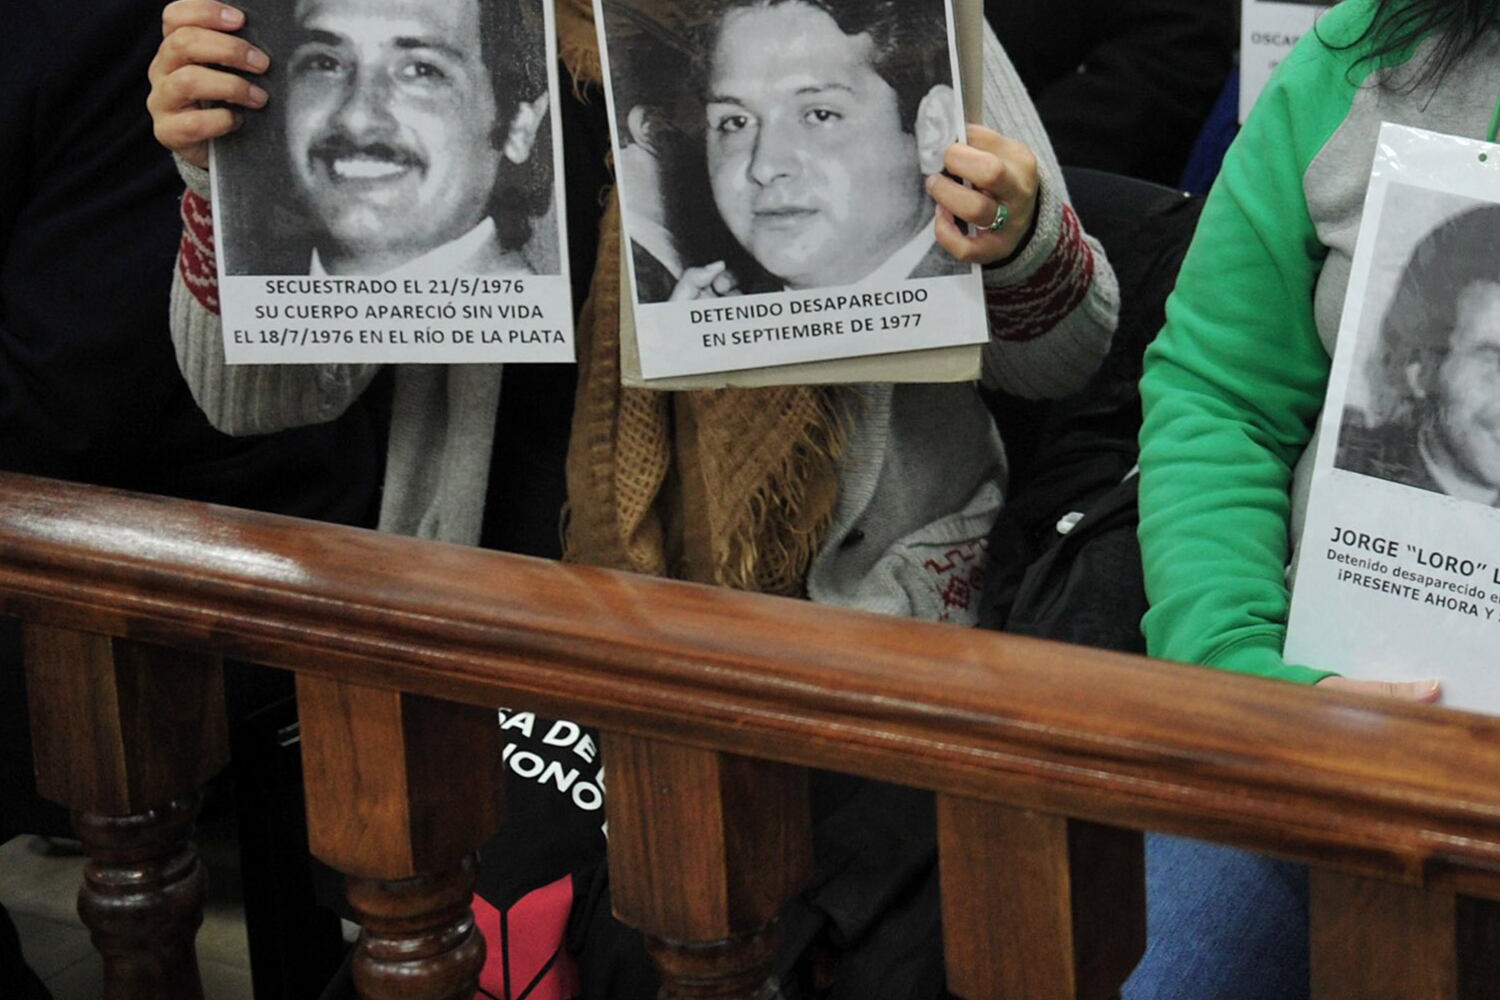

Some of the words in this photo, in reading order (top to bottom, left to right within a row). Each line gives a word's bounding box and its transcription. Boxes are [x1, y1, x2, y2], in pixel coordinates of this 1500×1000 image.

[266, 279, 398, 295] SECUESTRADO
[403, 279, 423, 294] EL
[428, 277, 525, 296] 21/5/1976
[255, 305, 279, 319] SU
[284, 305, 359, 320] CUERPO
[365, 301, 455, 319] APARECIÓ
[462, 304, 492, 319] SIN
[498, 304, 544, 319] VIDA
[690, 303, 783, 324] DETENIDO
[790, 289, 928, 315] DESAPARECIDO
[234, 330, 254, 344] EL
[259, 328, 354, 346] 18/7/1976
[359, 330, 383, 344] EN
[389, 330, 408, 344] EL
[414, 327, 446, 344] RÍO
[452, 330, 474, 344] DE
[481, 330, 503, 344] LA
[508, 330, 566, 344] PLATA
[703, 334, 726, 348] EN
[731, 321, 844, 345] SEPTIEMBRE
[851, 318, 874, 333] DE
[881, 313, 922, 330] 1977
[1330, 526, 1399, 558] JORGE
[1407, 544, 1487, 577] “LORO”
[1327, 549, 1388, 575] Detenido
[1392, 566, 1486, 600] desaparecido
[1337, 569, 1420, 601] ¡PRESENTE
[1424, 592, 1479, 617] AHORA
[1484, 607, 1495, 620] Y
[541, 719, 598, 764] DE
